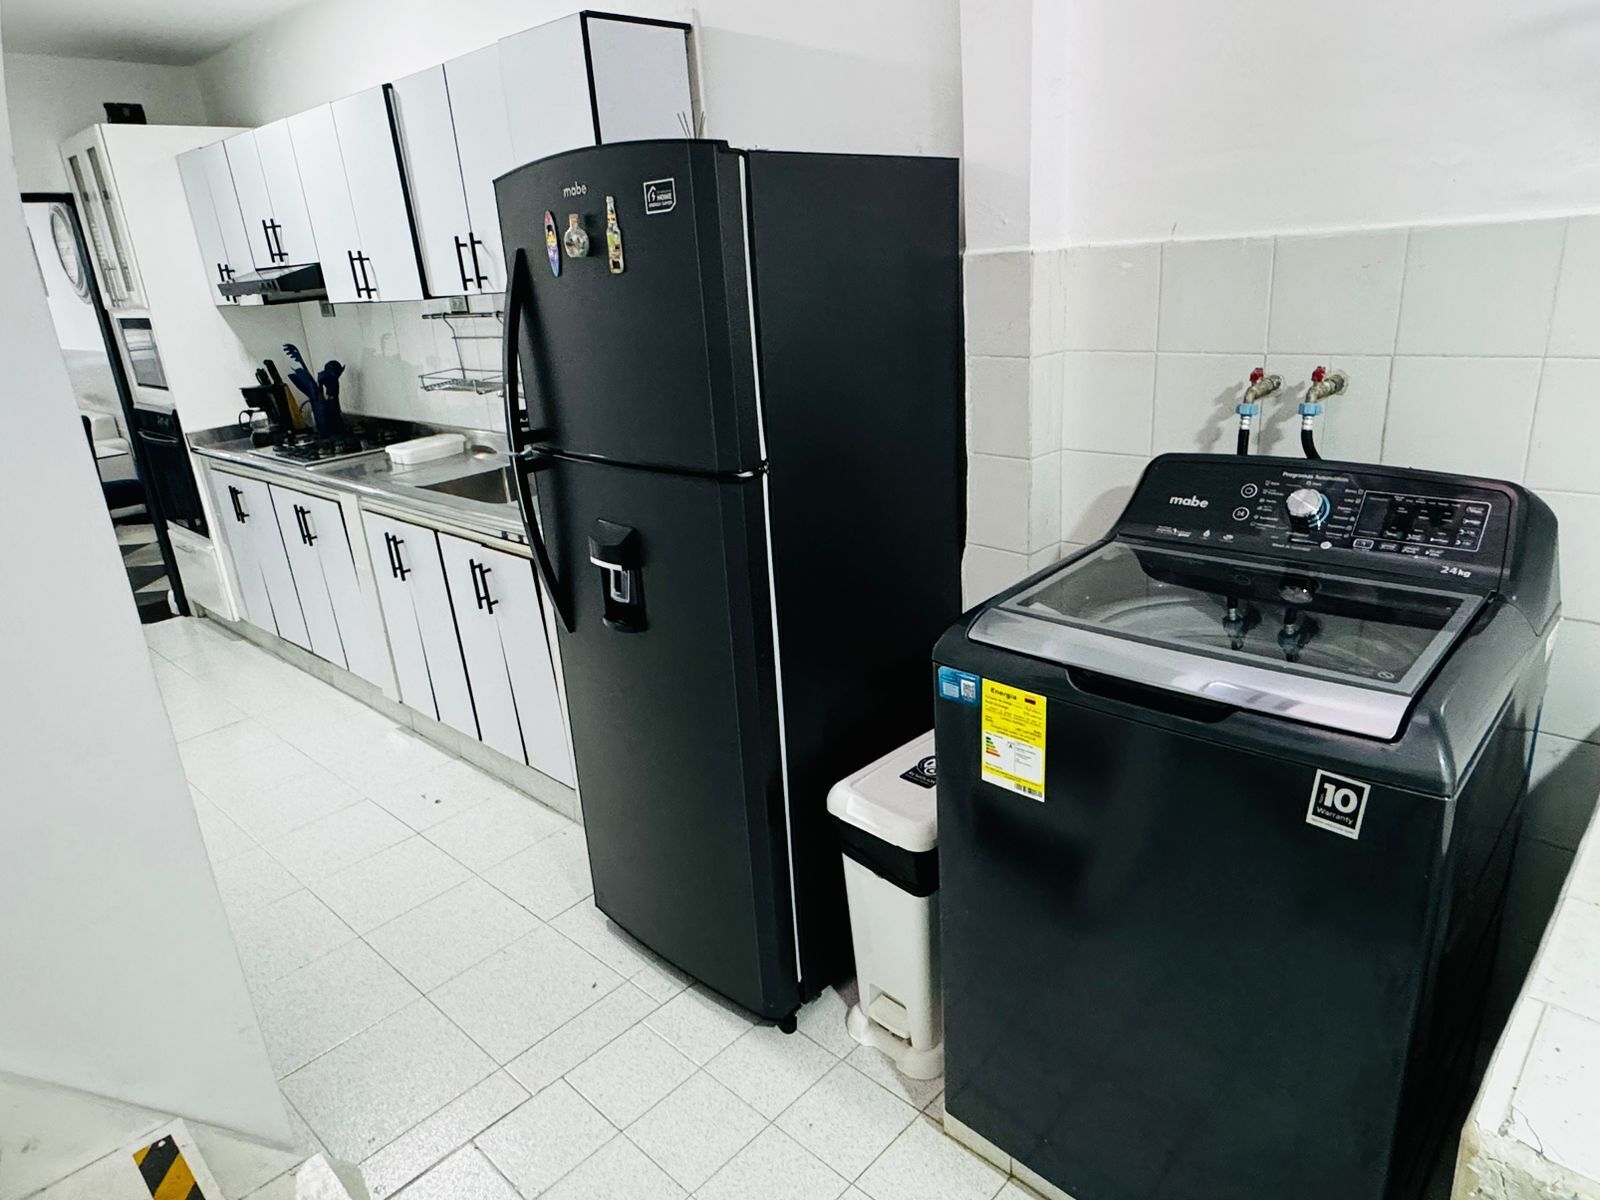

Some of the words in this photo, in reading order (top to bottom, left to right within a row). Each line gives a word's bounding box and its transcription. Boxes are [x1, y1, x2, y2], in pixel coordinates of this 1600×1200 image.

[563, 181, 587, 198] mabe
[1169, 495, 1209, 508] mabe
[1323, 782, 1358, 814] 10
[1316, 806, 1354, 825] Warranty
